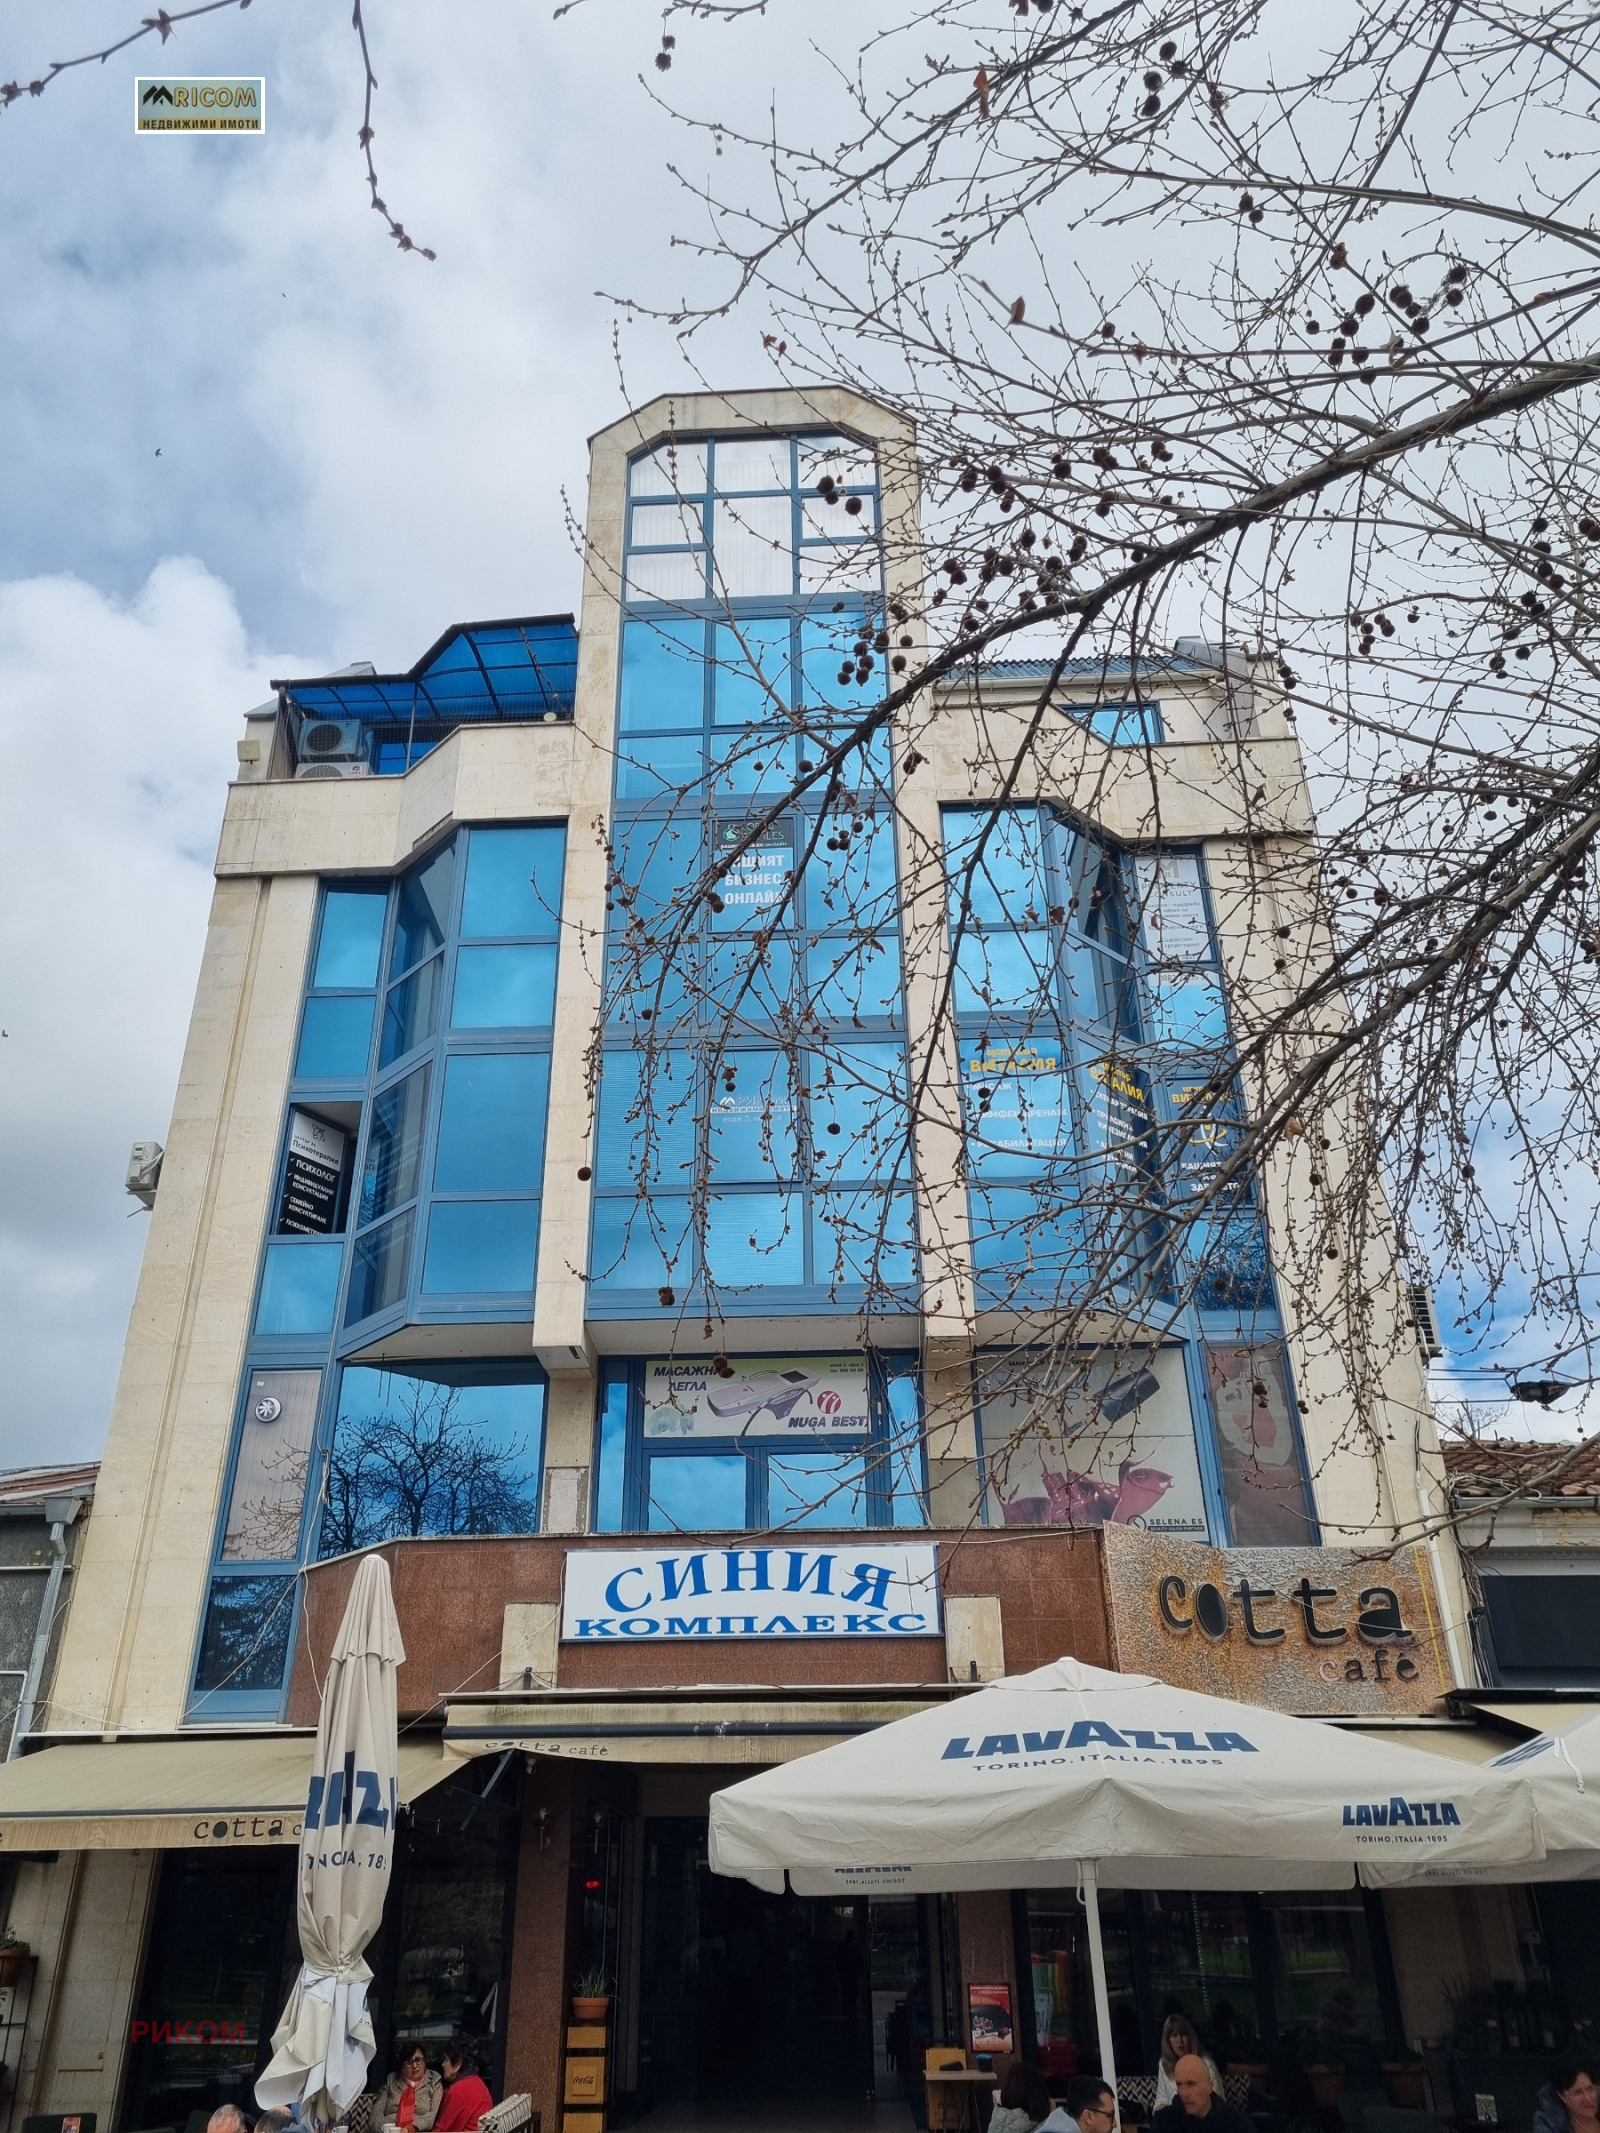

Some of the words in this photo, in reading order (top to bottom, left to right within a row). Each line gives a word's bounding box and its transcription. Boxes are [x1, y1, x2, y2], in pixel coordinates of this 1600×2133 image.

[731, 855, 785, 868] АШИЯТ
[725, 873, 781, 886] БИЗНЕС
[970, 1058, 1057, 1073] ВИТАЛИЯ
[292, 1139, 339, 1165] Психотерапия
[296, 1160, 336, 1183] ПСИХОЛОГ
[292, 1181, 329, 1201] КОНСУЛТАЦИИ
[290, 1196, 314, 1211] СЕМЕЙНО
[288, 1204, 327, 1224] КОНСУЛТИРАНЕ
[668, 1381, 707, 1392] ЛЕГЛА
[788, 1417, 826, 1428] NUGA
[831, 1416, 868, 1428] BEST
[604, 1550, 897, 1614] СИНИЯ
[1159, 1575, 1413, 1642] cotta
[574, 1613, 928, 1637] КОМПЛЕКС
[941, 1720, 1260, 1760] LAVAZZA
[1169, 1758, 1224, 1766] 1895
[1343, 1797, 1462, 1827] LAVAZZA
[194, 1816, 284, 1839] cotta
[1427, 1835, 1448, 1843] 1895
